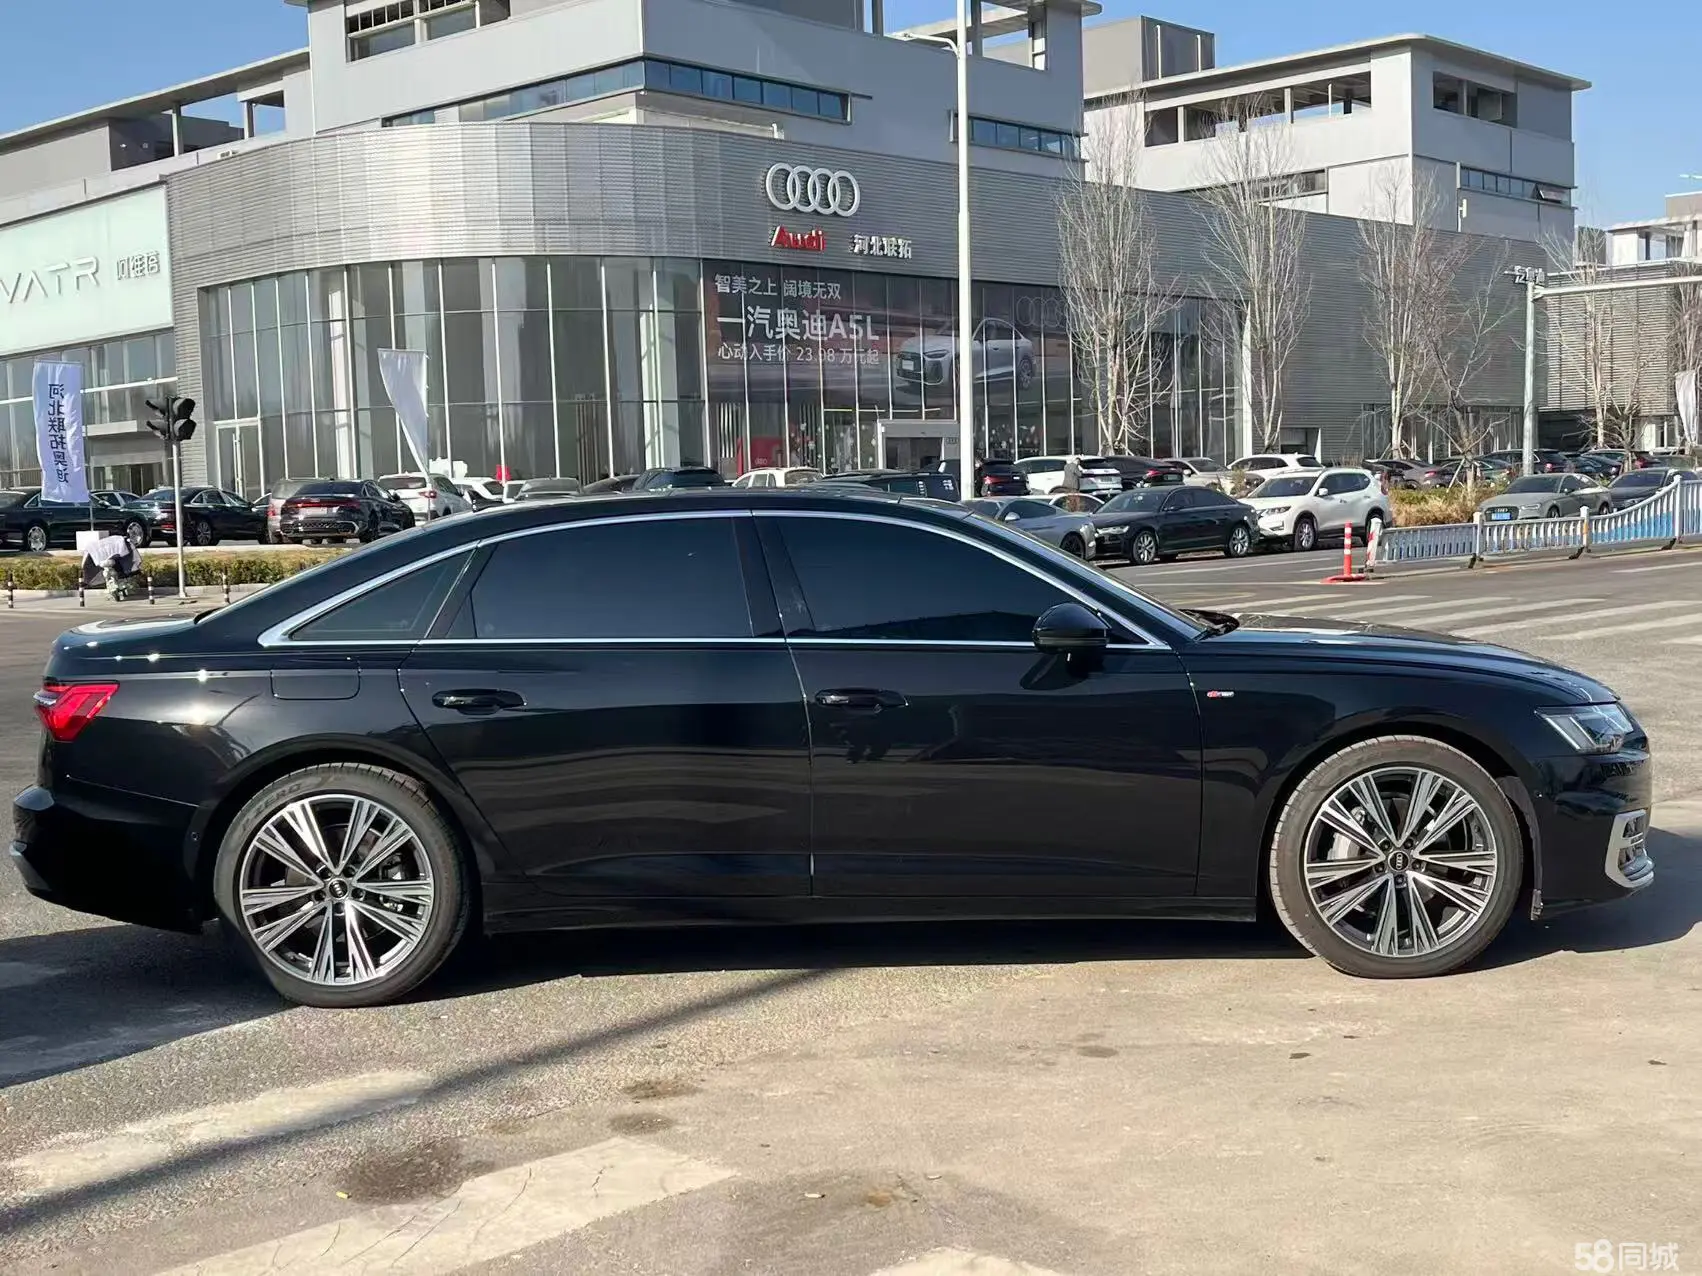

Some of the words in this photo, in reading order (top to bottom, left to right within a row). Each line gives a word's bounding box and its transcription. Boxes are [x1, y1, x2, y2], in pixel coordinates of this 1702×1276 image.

[770, 224, 826, 252] Audi
[851, 233, 912, 259] 河北联拓
[714, 273, 778, 296] 智美之上
[783, 279, 842, 301] 阔境无双
[716, 305, 880, 341] 一汽奥迪A5L
[717, 341, 792, 362] 心动入手价
